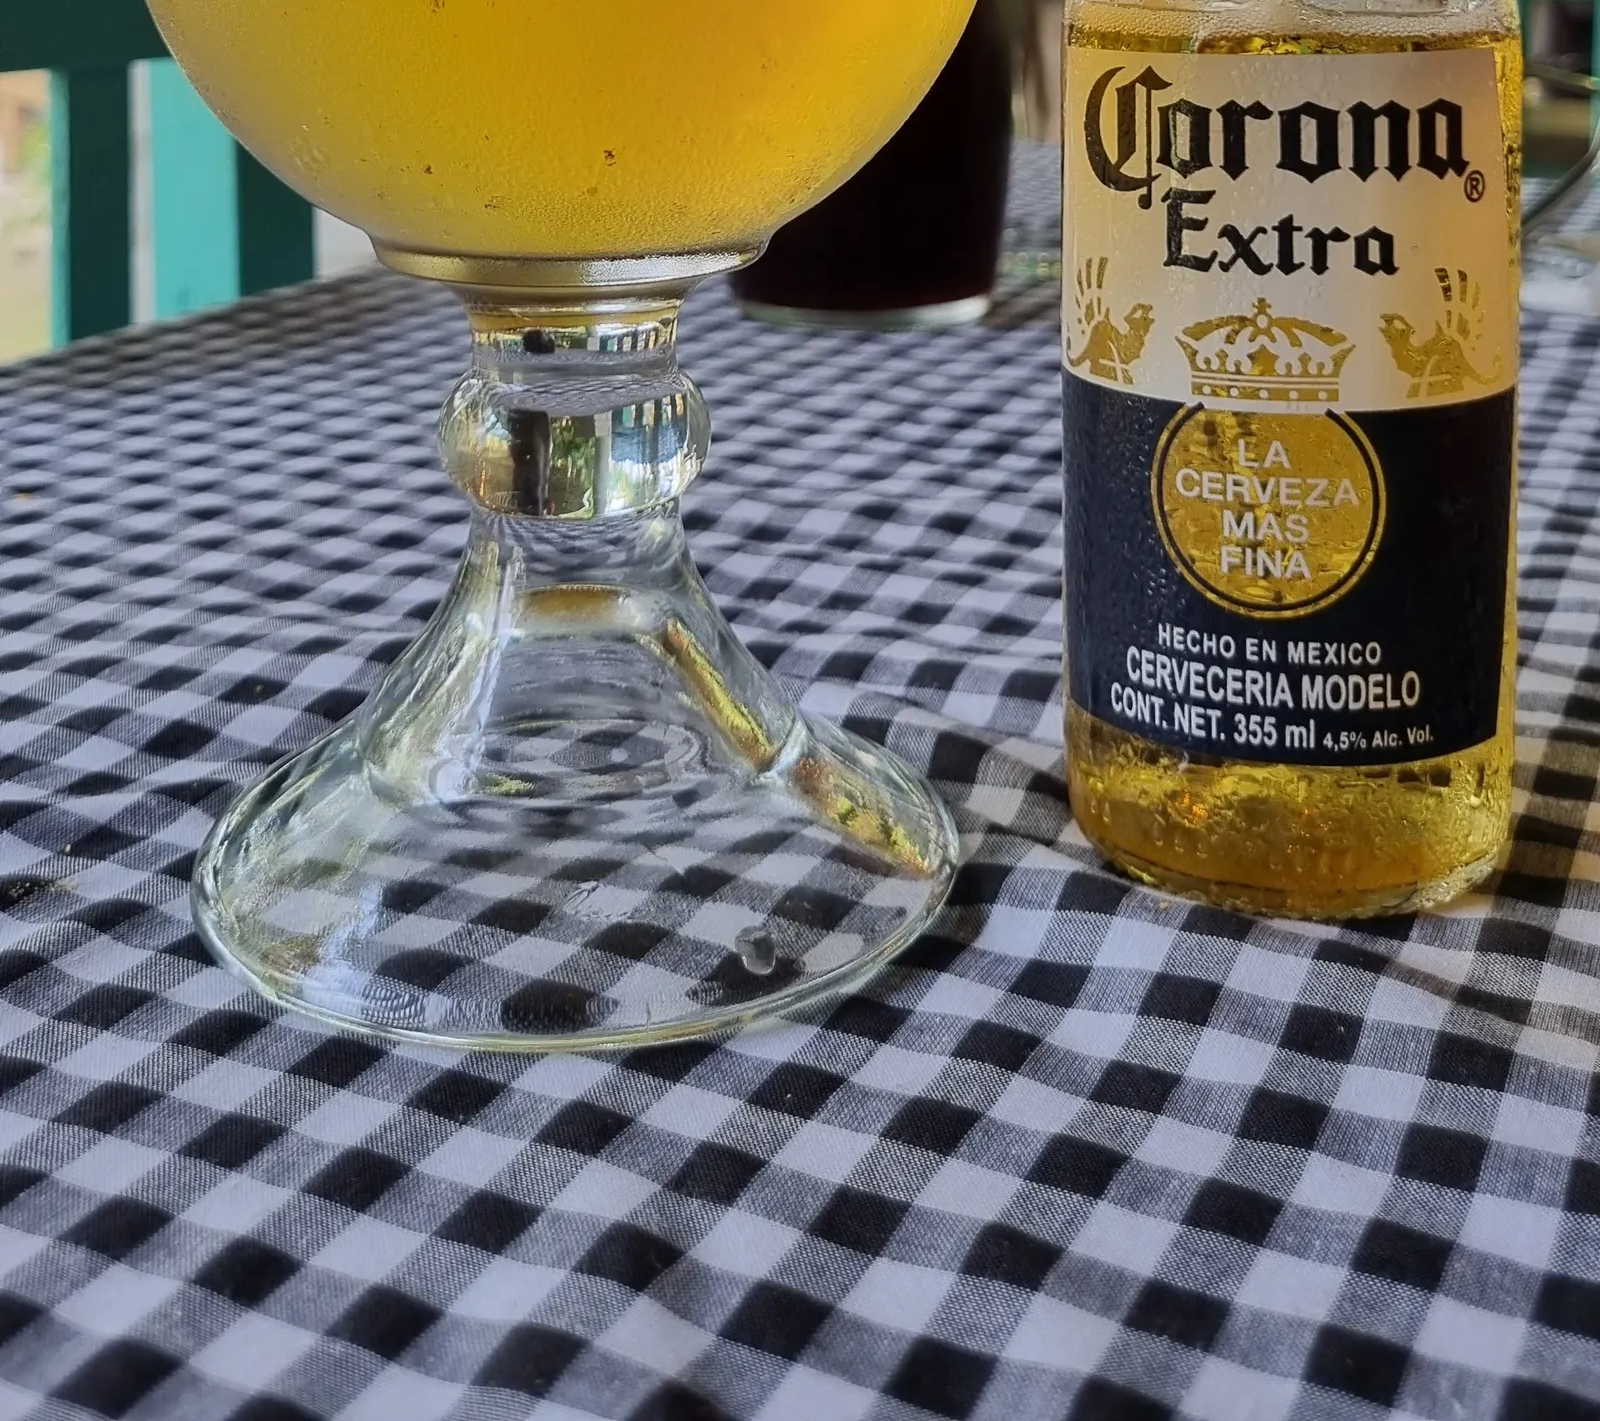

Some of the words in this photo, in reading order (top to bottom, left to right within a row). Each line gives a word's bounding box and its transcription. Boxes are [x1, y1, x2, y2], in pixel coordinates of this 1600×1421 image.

[1083, 65, 1470, 210] Corona
[1160, 186, 1400, 277] Extra
[1237, 438, 1292, 470] LA
[1175, 467, 1360, 507] CERVEZA
[1222, 508, 1310, 544] MAS
[1220, 545, 1312, 580] FINA
[1157, 622, 1236, 659] HECHO
[1245, 636, 1278, 663] EN
[1287, 640, 1382, 667] MEXICO
[1126, 645, 1295, 709] CERVECERIA
[1301, 670, 1421, 711] MODELO
[1110, 681, 1169, 729] CONT.
[1173, 701, 1226, 741] NET.
[1233, 712, 1278, 746] 355
[1284, 718, 1316, 749] ml
[1322, 731, 1368, 752] 4,5%
[1371, 729, 1403, 748] Alc.
[1406, 724, 1434, 745] Vol.
